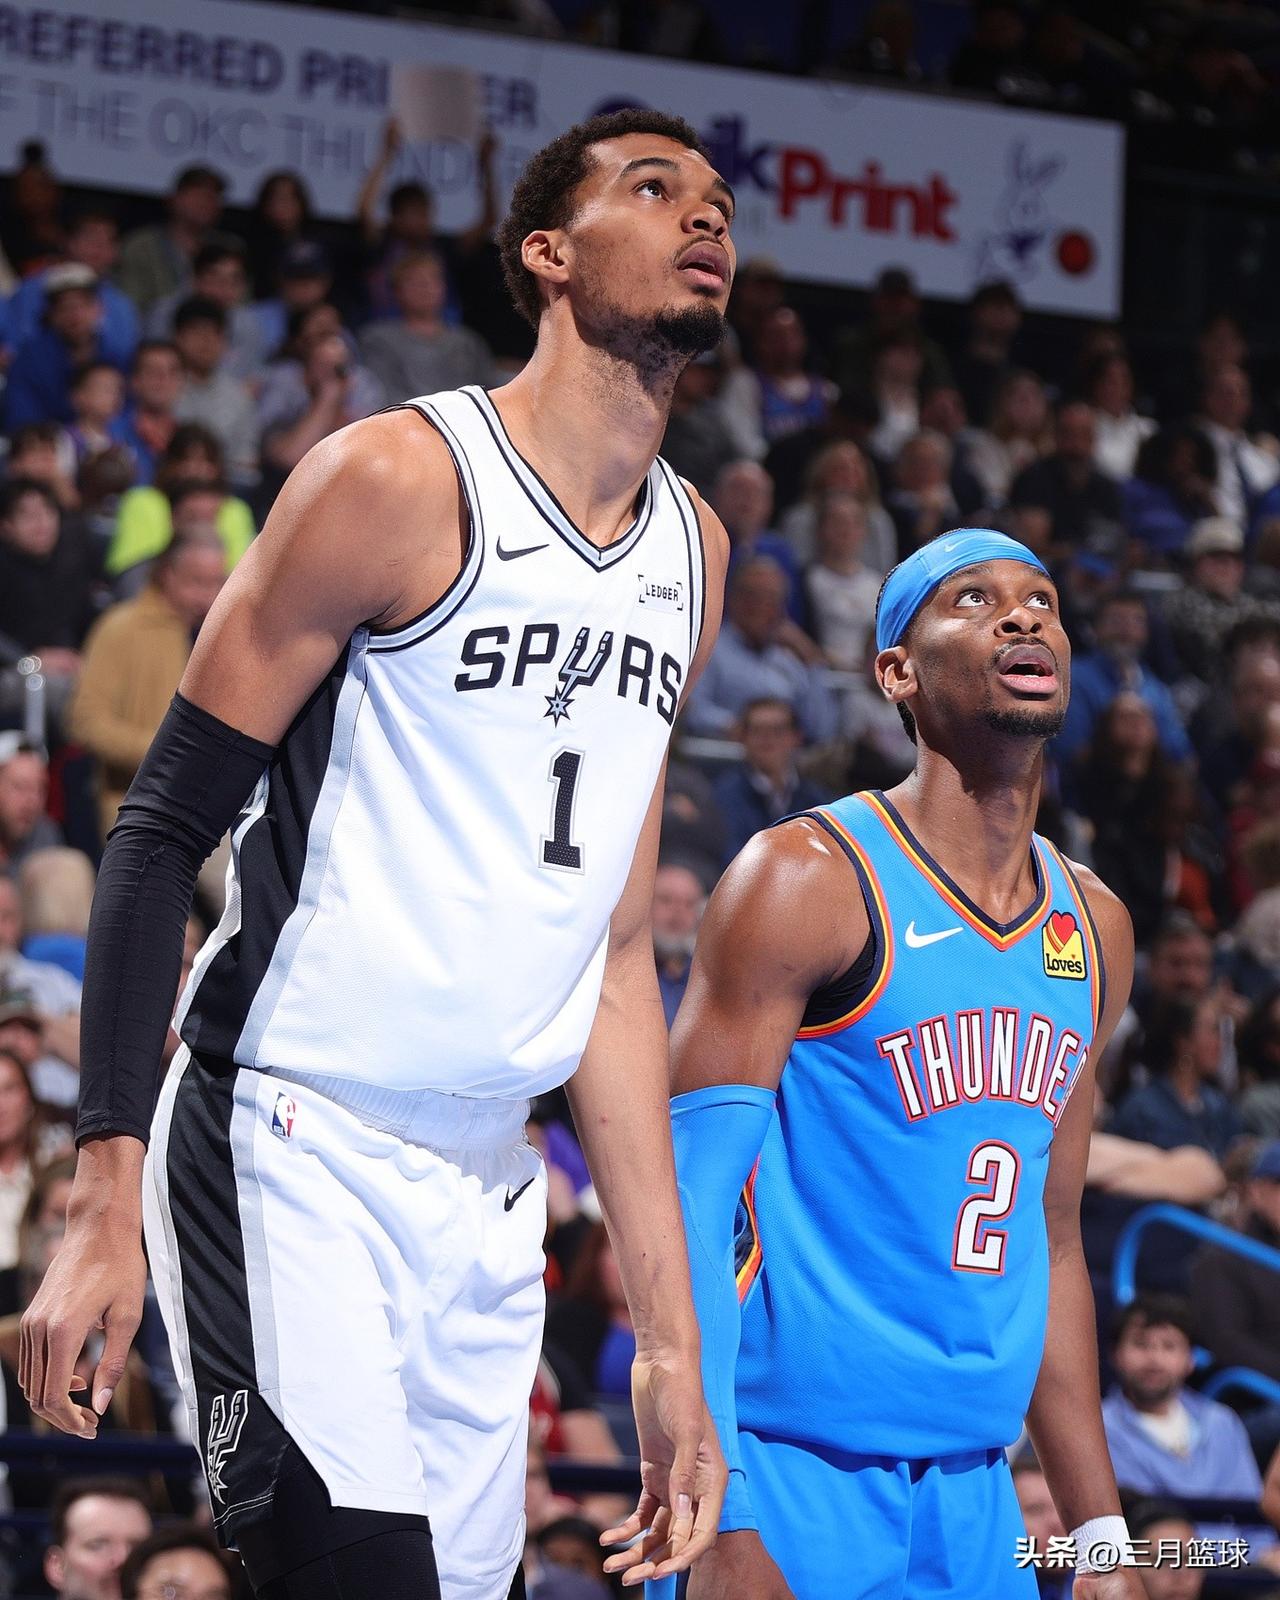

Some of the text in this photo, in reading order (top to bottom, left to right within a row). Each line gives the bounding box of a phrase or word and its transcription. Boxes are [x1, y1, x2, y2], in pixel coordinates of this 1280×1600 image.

[149, 97, 268, 167] OKC
[646, 583, 679, 602] LEDGER
[454, 623, 682, 727] SPURS
[540, 747, 585, 874] 1
[953, 1139, 1021, 1275] 2
